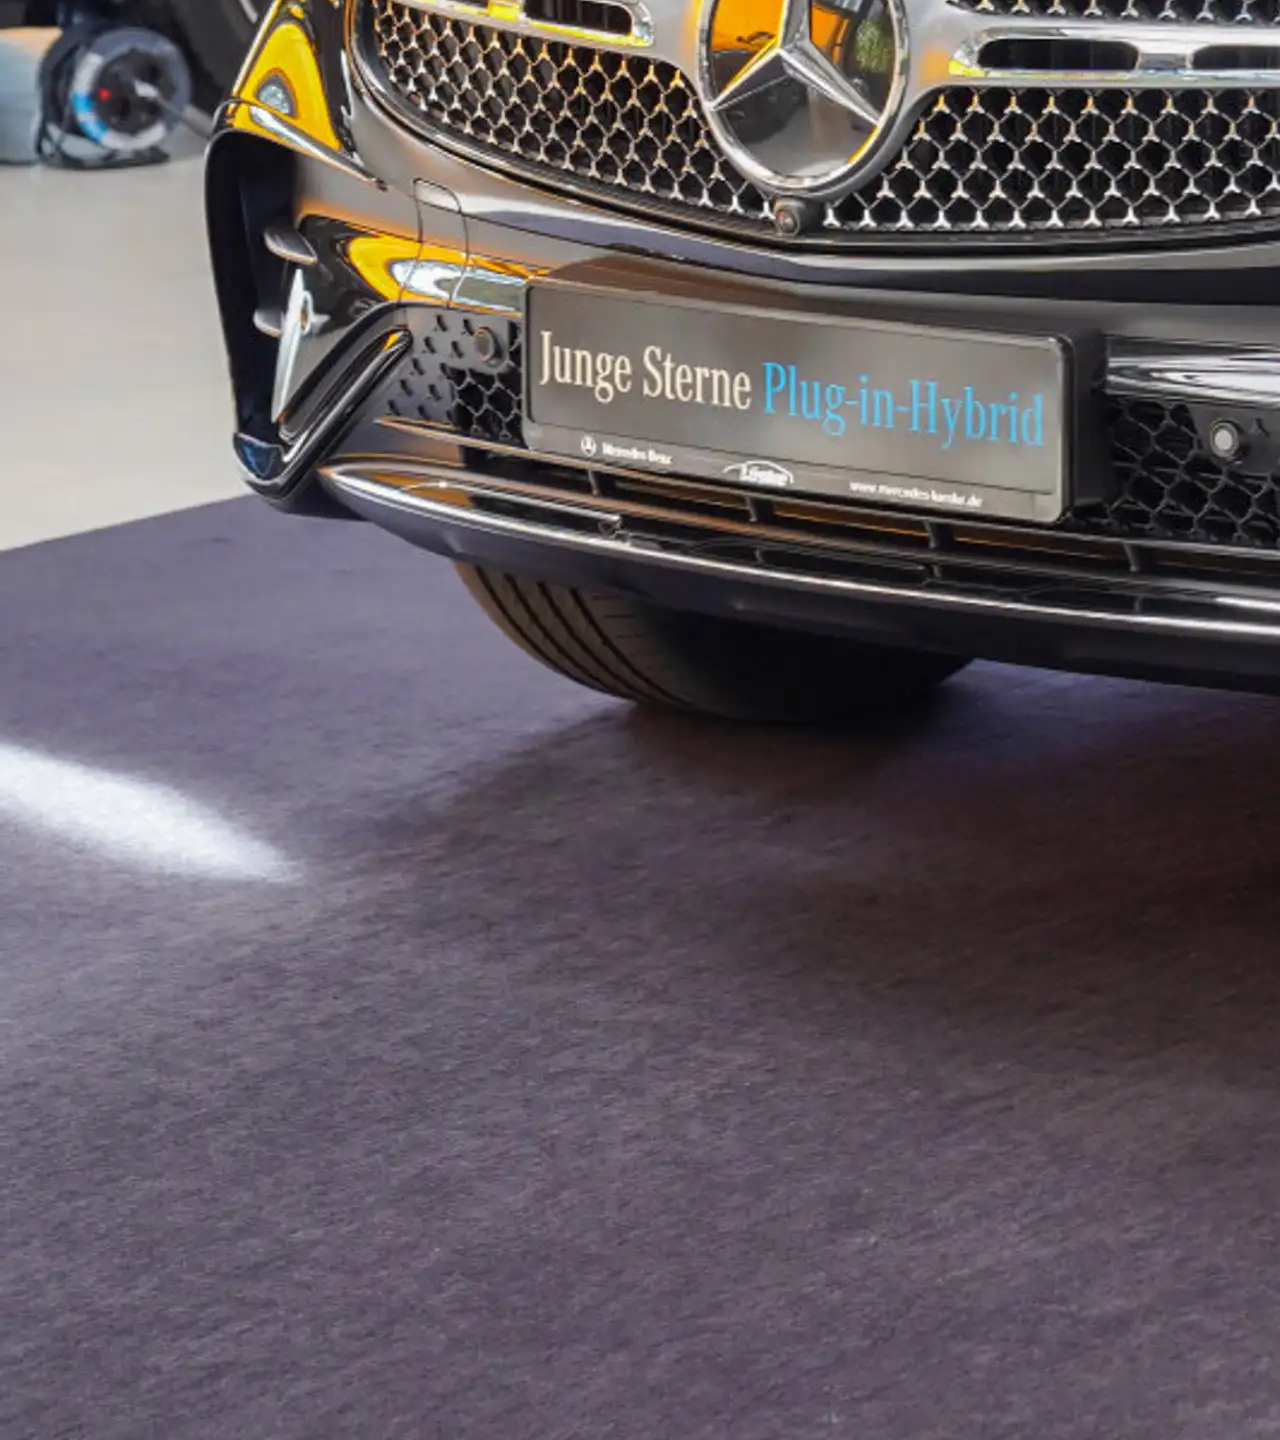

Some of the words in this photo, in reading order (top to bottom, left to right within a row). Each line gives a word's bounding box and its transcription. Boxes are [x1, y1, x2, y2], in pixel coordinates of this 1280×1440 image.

[539, 329, 633, 404] Junge
[642, 345, 752, 410] Sterne
[762, 361, 1045, 450] Plug-in-Hybrid
